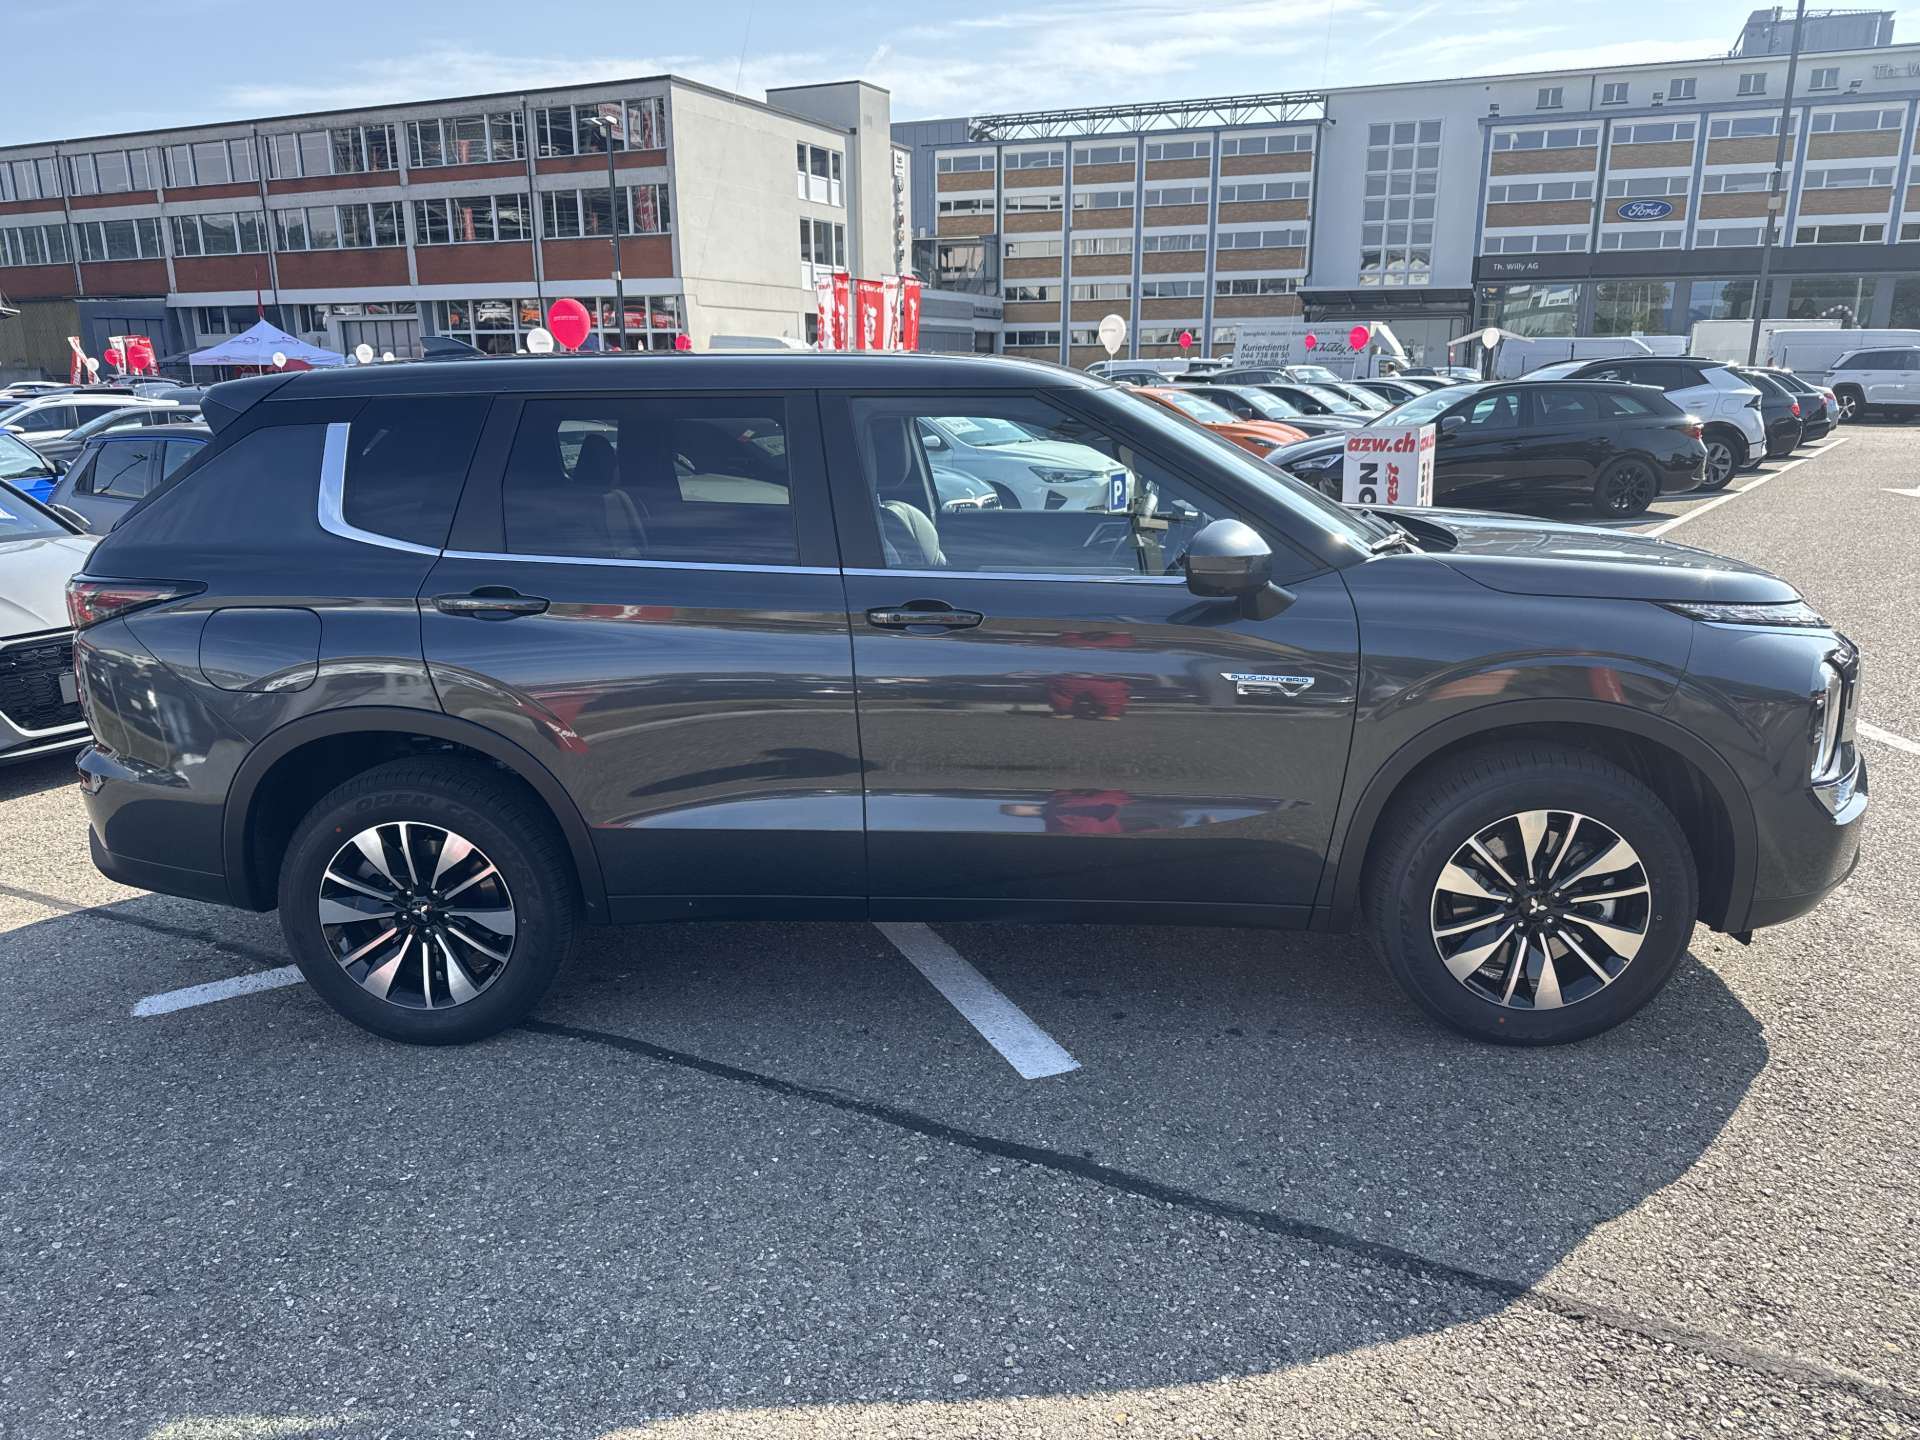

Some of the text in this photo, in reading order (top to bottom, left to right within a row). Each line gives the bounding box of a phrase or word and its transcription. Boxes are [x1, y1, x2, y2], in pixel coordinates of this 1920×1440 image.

[1628, 202, 1662, 216] Ford
[1493, 262, 1539, 272] Th. Willy AG
[1241, 343, 1290, 351] Kurierdienst
[1347, 431, 1416, 453] azw.ch
[1113, 480, 1123, 506] P
[1231, 673, 1309, 683] PLUG-IN HYBRID
